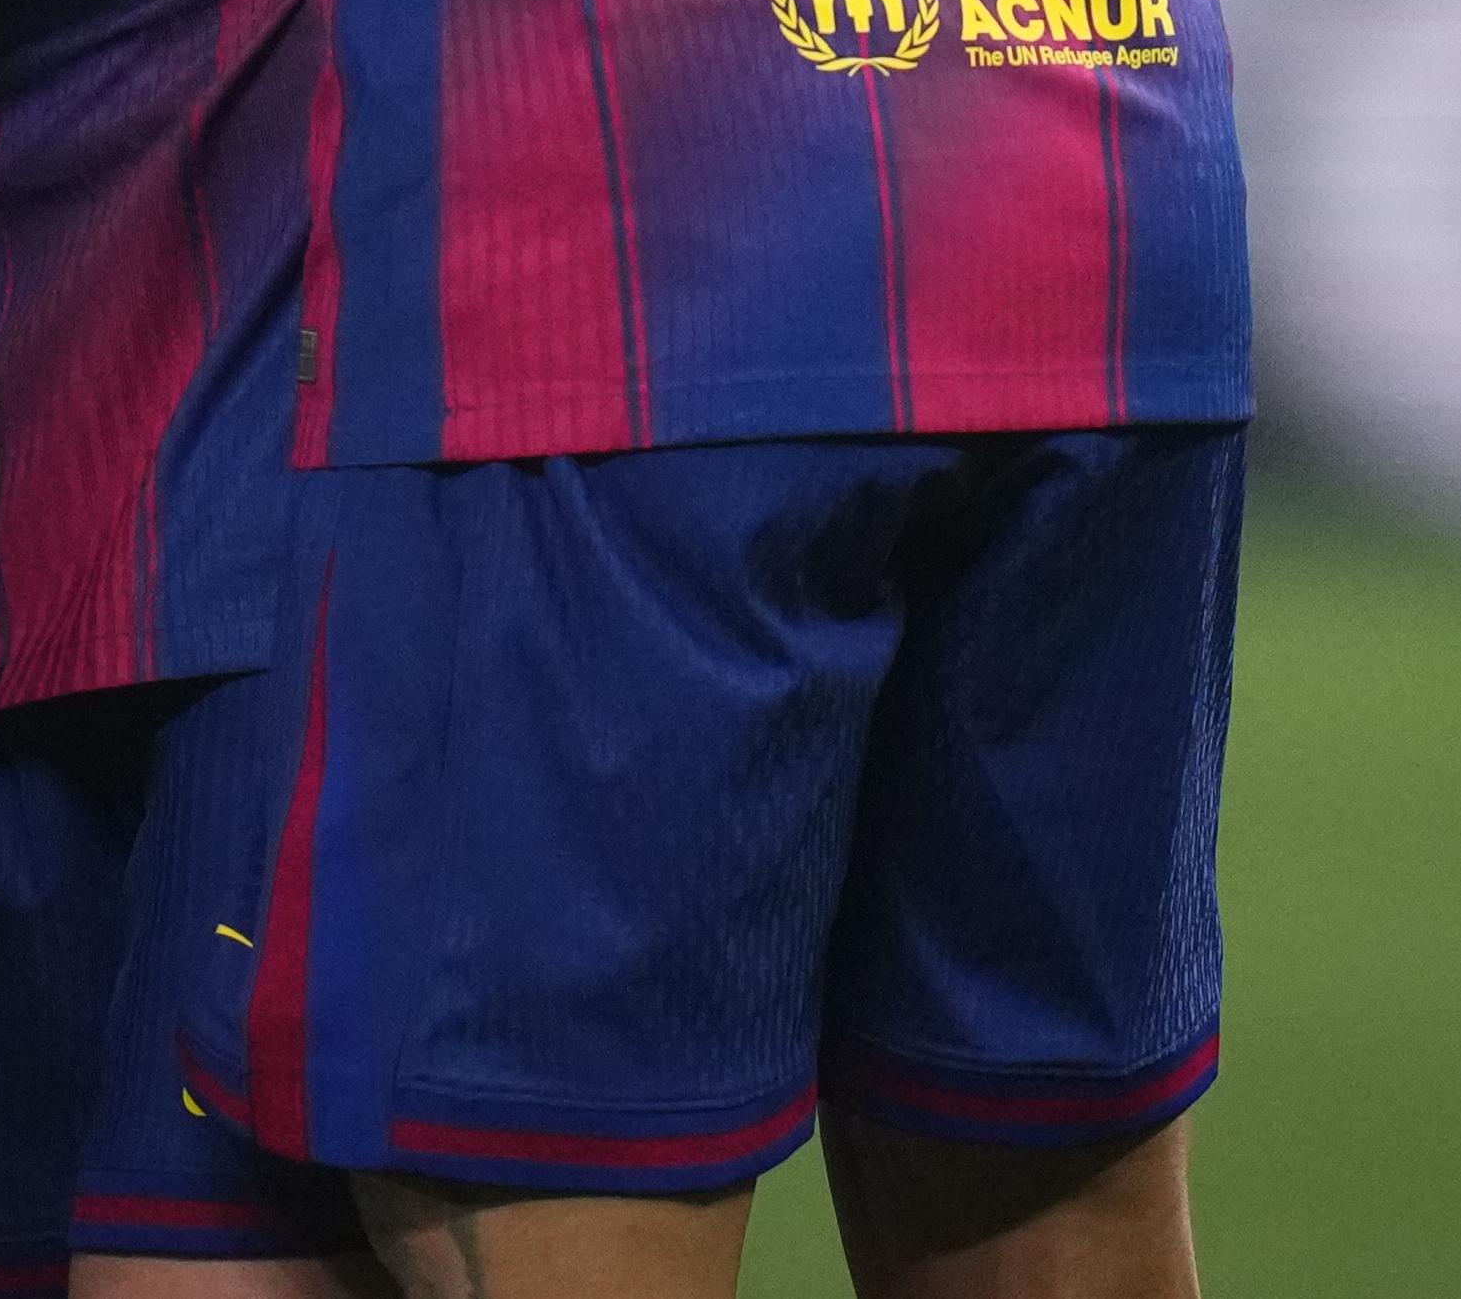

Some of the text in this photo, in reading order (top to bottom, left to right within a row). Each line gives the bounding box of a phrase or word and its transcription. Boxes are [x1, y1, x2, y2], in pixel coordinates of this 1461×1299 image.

[965, 46, 1179, 68] The UN Refugee Agency
